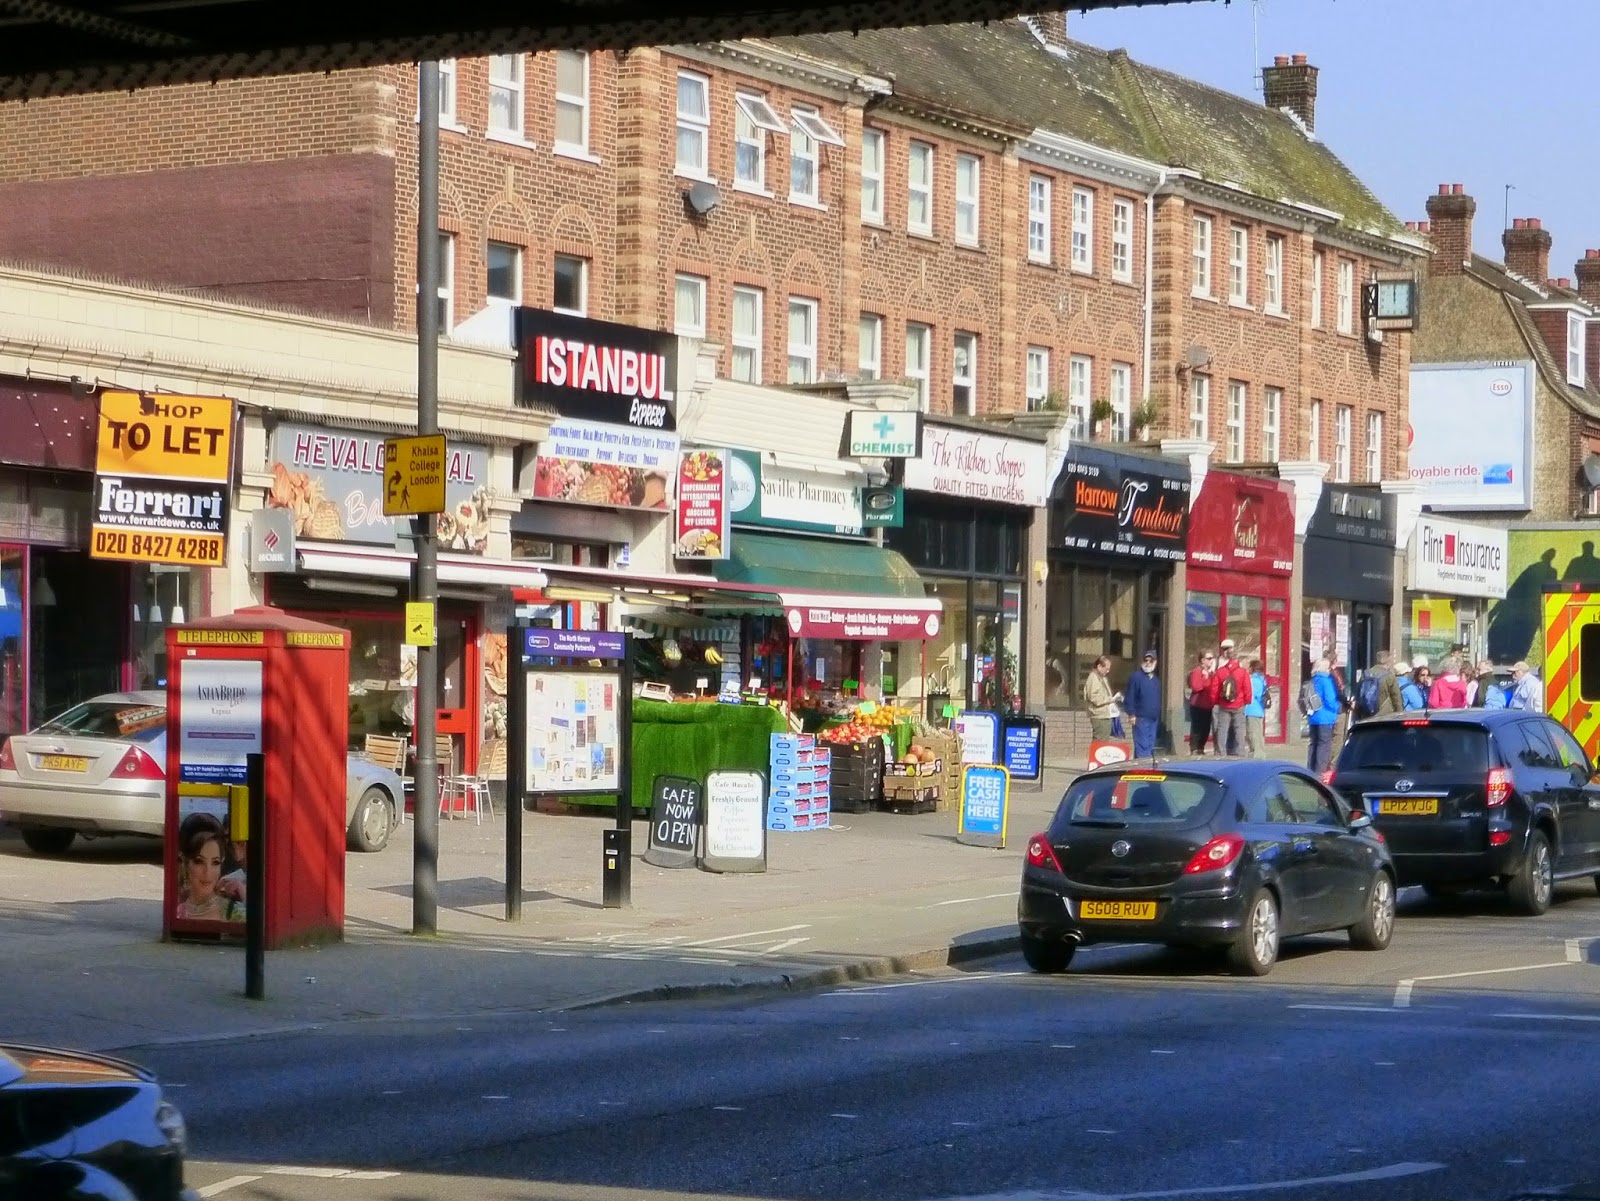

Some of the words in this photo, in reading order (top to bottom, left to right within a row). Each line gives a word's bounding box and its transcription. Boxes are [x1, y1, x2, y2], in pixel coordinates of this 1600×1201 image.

[536, 336, 673, 401] ISTANBUL
[629, 398, 666, 427] EXPRESS
[107, 420, 151, 451] TO
[163, 424, 224, 456] LET
[411, 445, 439, 457] Khalsa
[852, 442, 914, 454] CHEMIST
[932, 432, 950, 467] The
[409, 460, 441, 473] College
[1454, 464, 1481, 476] ride.
[410, 474, 440, 486] London
[799, 480, 848, 511] Pharmacy
[933, 476, 961, 493] QUALITY
[965, 481, 988, 497] FITTED
[991, 485, 1025, 502] KITCHENS
[1075, 480, 1118, 510] Harrow
[99, 479, 222, 519] Ferrari
[1118, 477, 1185, 532] Tandoori
[99, 514, 219, 531] www.ferraridewe.co.uk
[96, 531, 127, 554] 020
[132, 534, 173, 558] 8427
[176, 538, 219, 561] 4288
[1423, 526, 1443, 564] Flint
[1457, 530, 1501, 571] Insurance
[184, 631, 258, 643] TELEPHONE
[291, 633, 340, 646] TELEPHONE
[968, 775, 1001, 788] FREE
[711, 795, 735, 805] Freshly
[735, 795, 759, 803] Ground
[968, 788, 1000, 800] CASH
[665, 803, 694, 820] NOW
[967, 806, 1000, 818] HERE
[1383, 801, 1408, 811] LP12
[657, 820, 696, 845] OPEN
[1087, 902, 1120, 915] SG08
[1124, 903, 1150, 916] RUV
